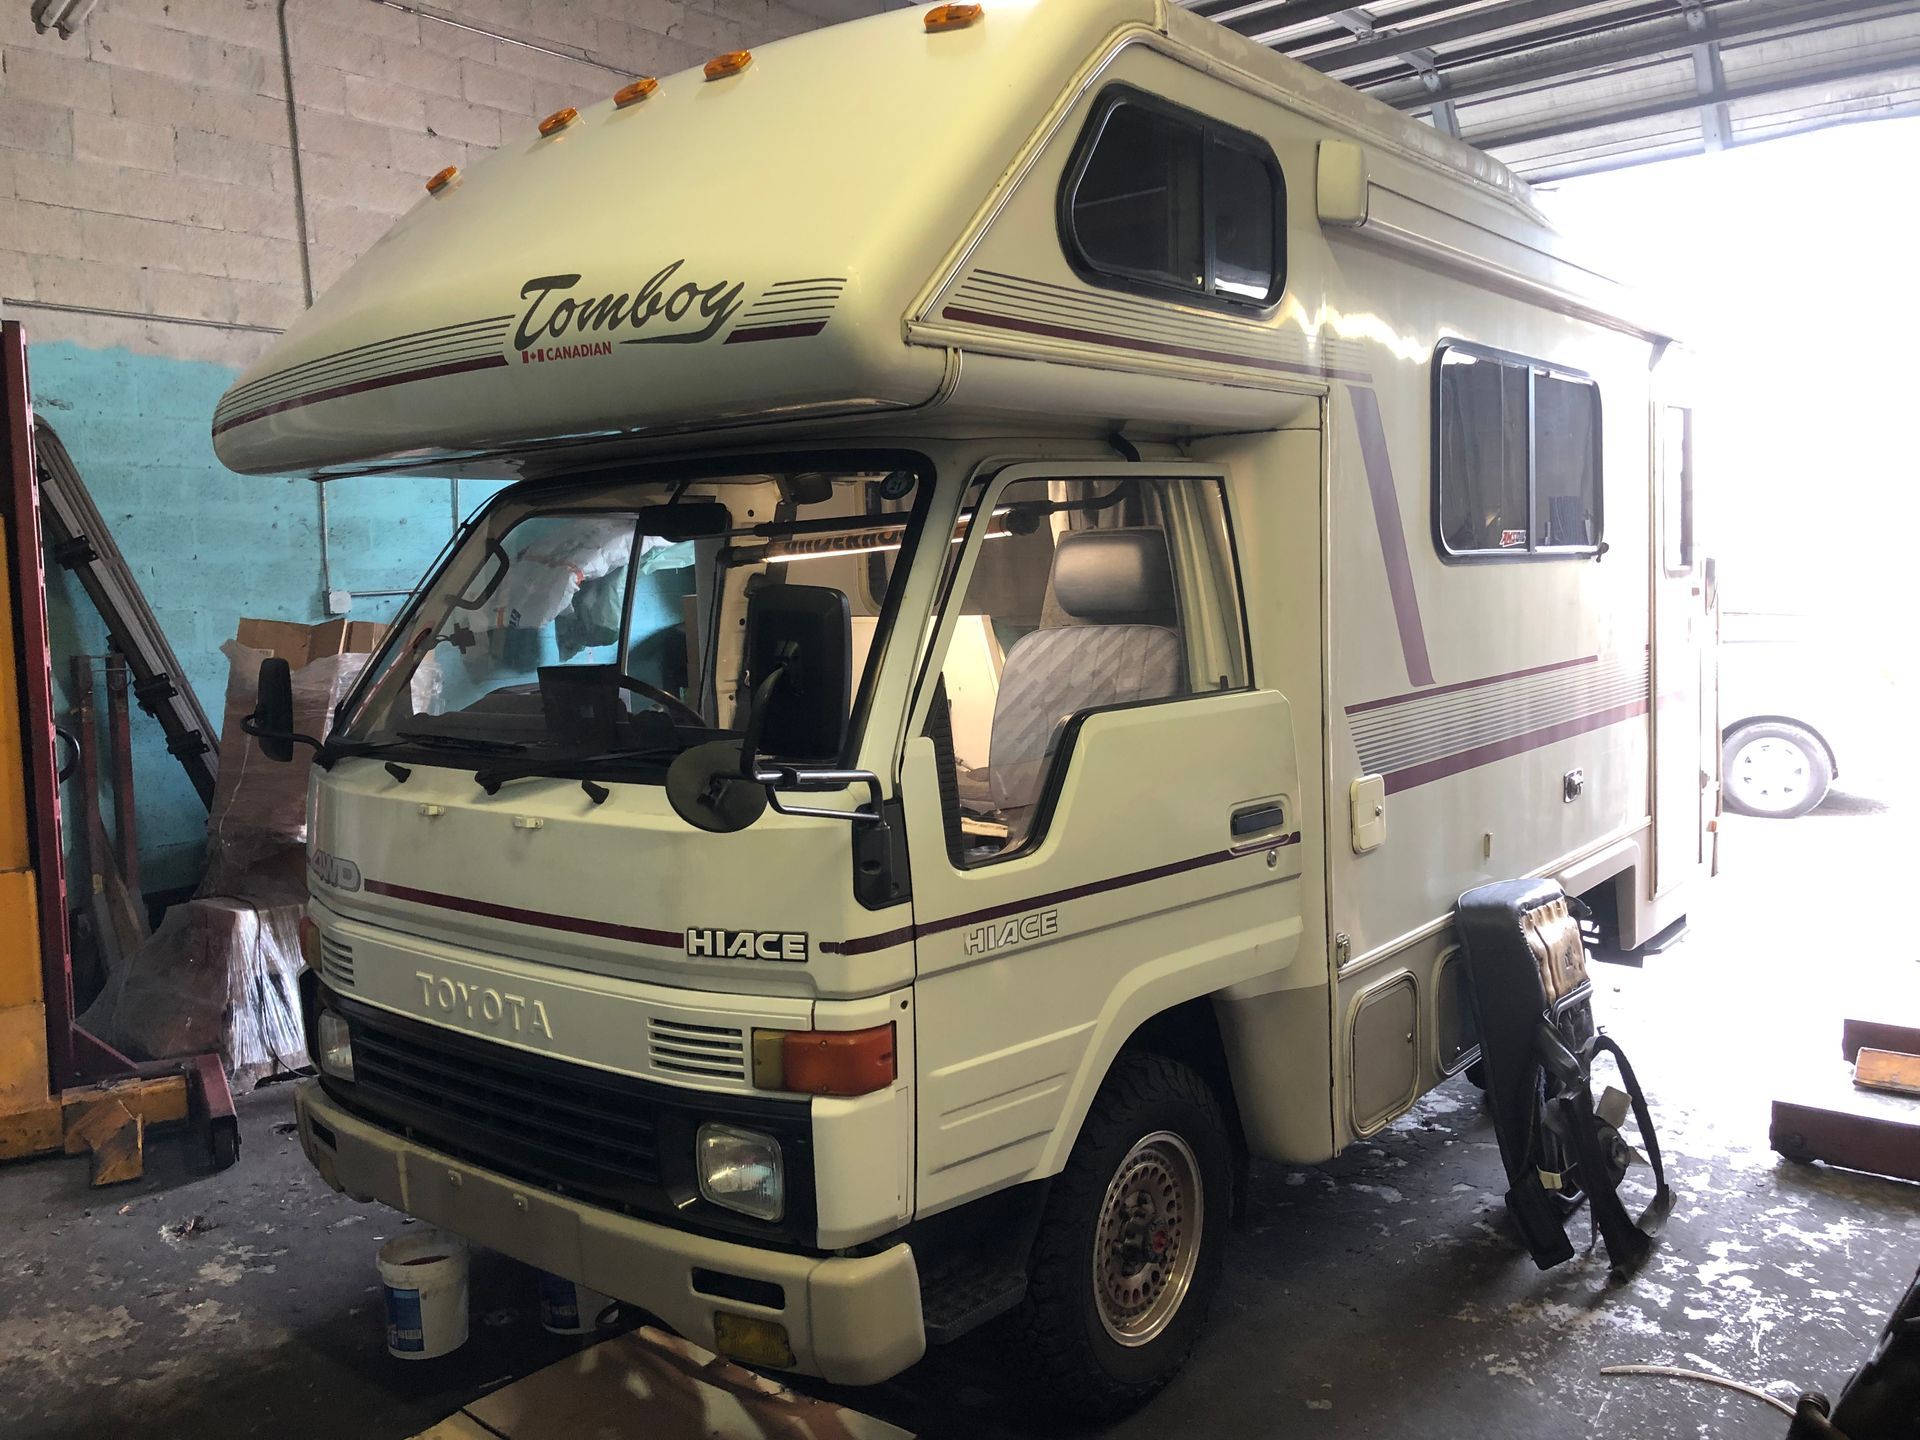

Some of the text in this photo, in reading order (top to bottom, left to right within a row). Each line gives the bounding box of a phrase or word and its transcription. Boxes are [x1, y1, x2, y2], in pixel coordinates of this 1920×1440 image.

[514, 259, 744, 351] Tomboy
[546, 341, 613, 361] CANADIAN
[687, 928, 807, 961] HIACE
[963, 909, 1058, 956] HIACE
[415, 970, 554, 1040] TOYOTA
